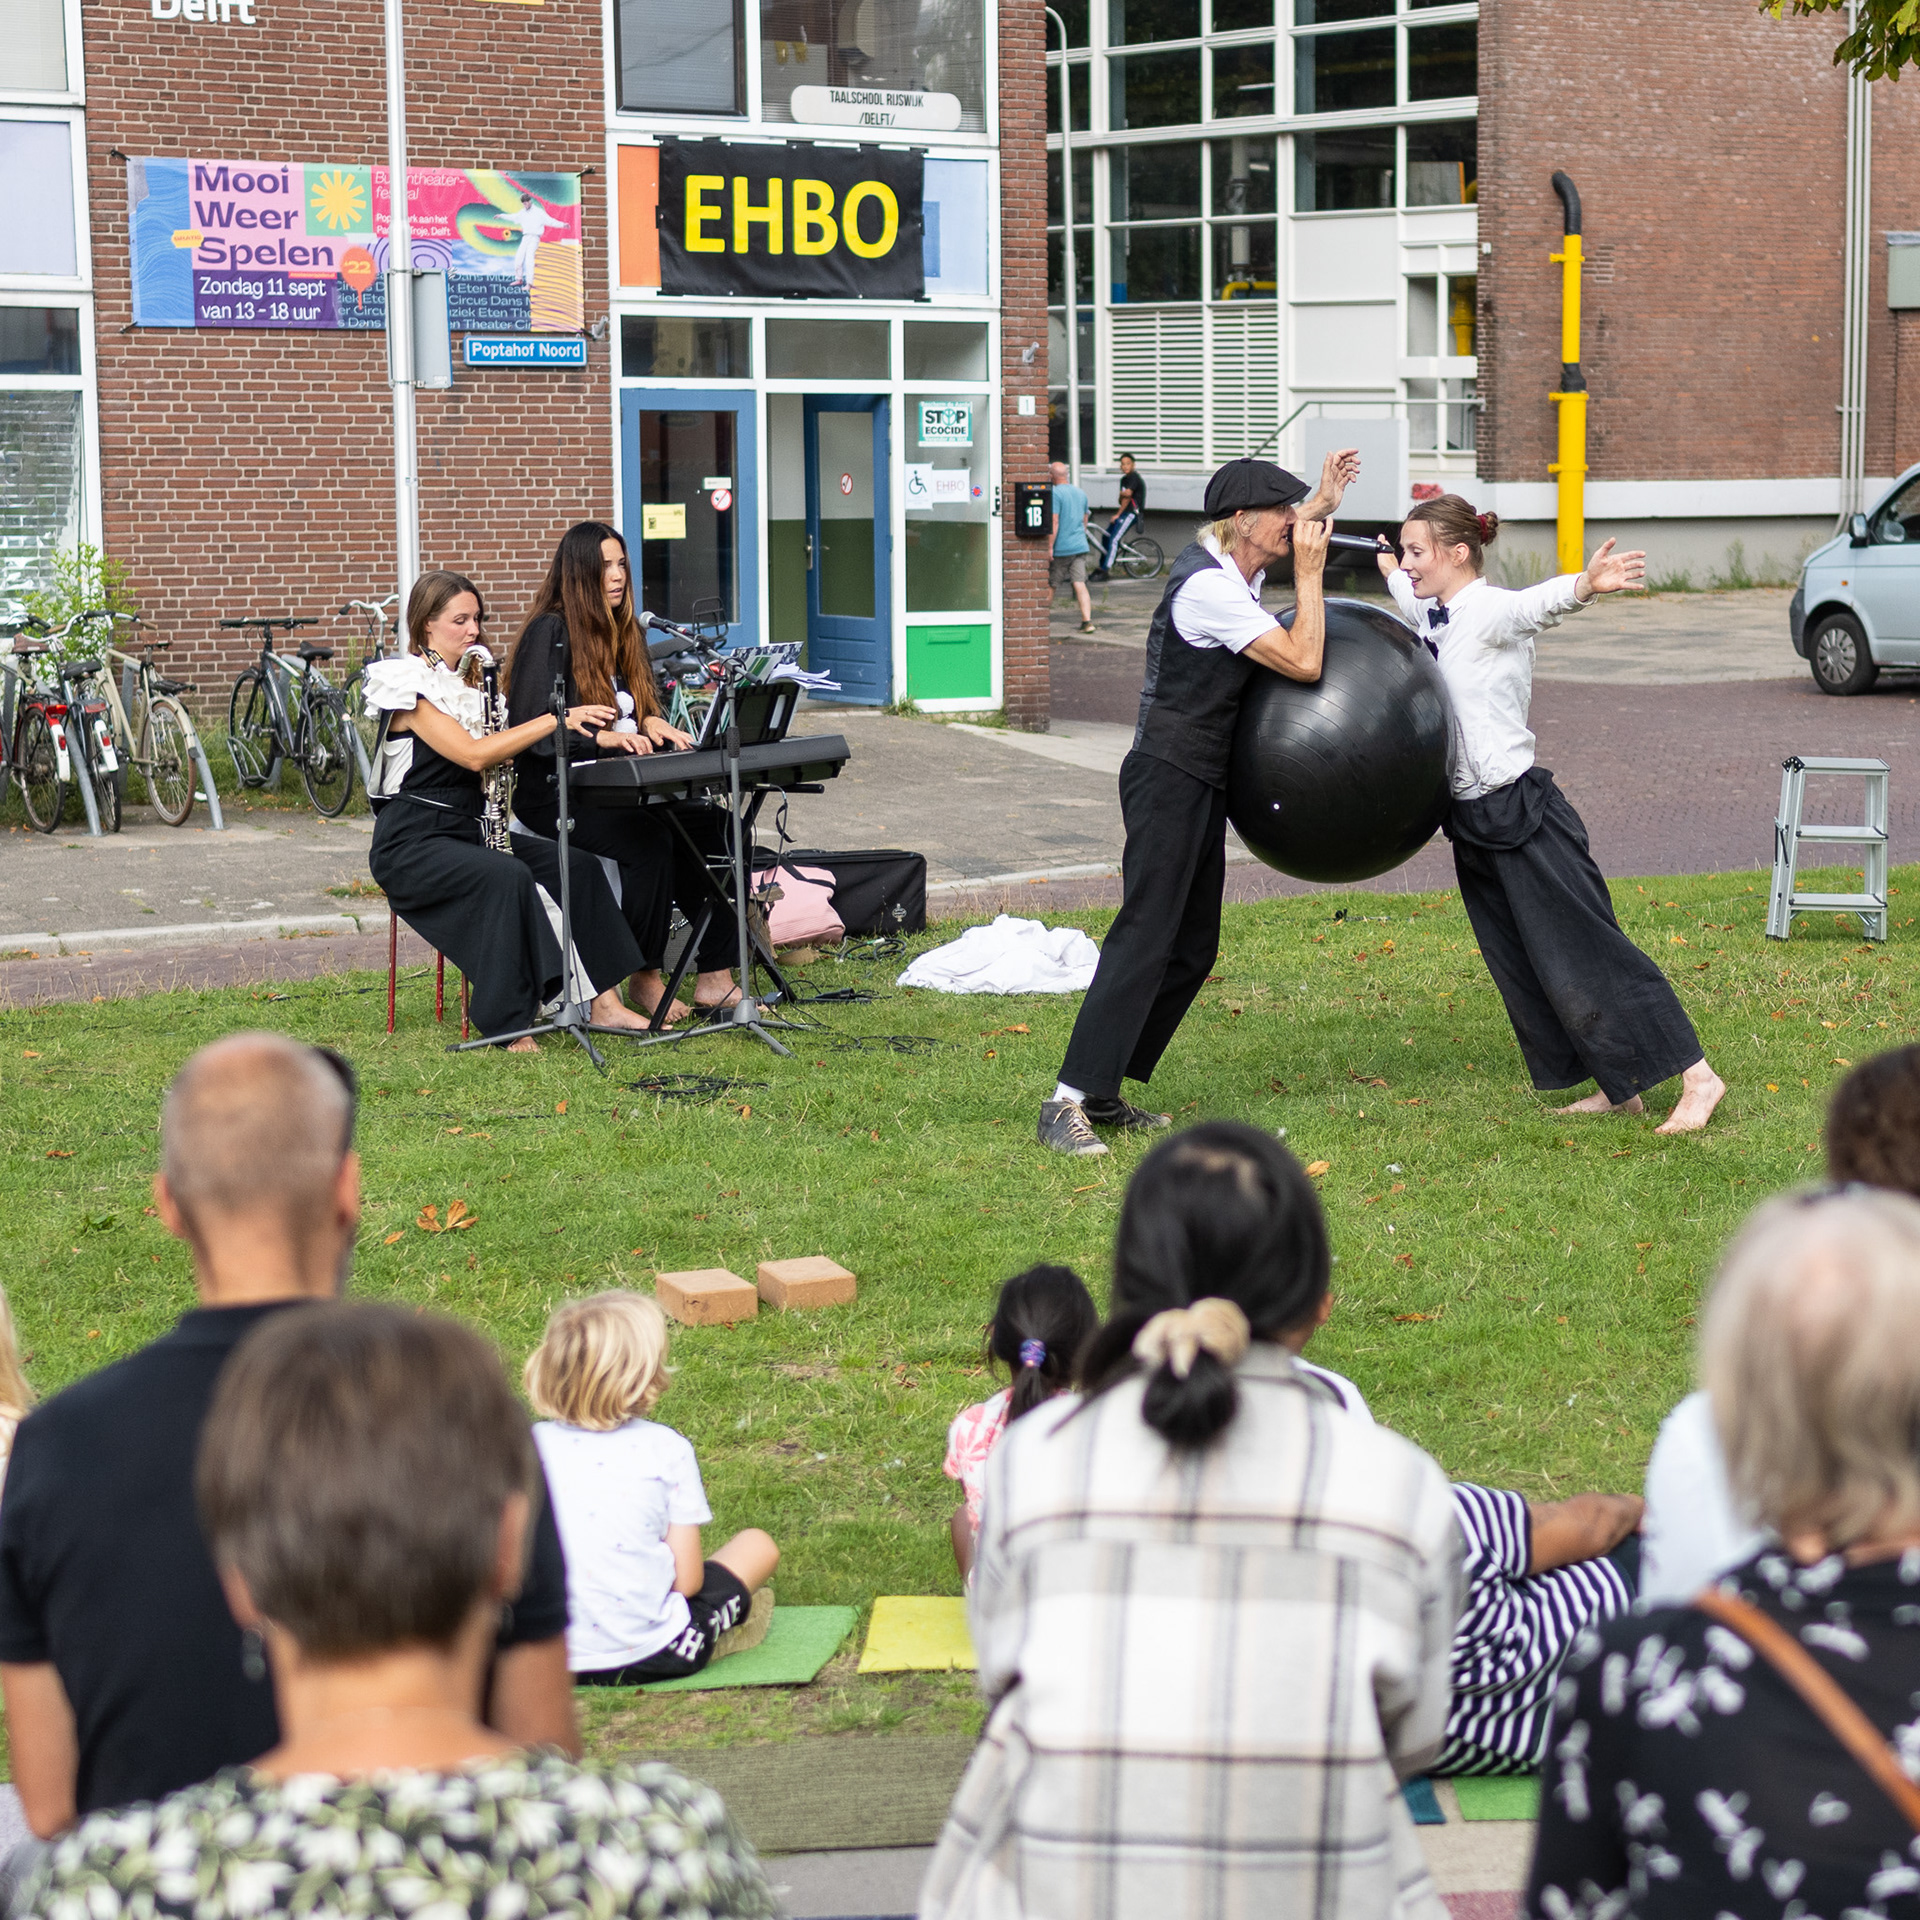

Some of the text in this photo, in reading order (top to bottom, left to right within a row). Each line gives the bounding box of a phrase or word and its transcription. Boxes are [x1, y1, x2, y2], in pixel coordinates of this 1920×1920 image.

[830, 90, 924, 107] TAALSCHOOL RIJSWIJK
[195, 165, 289, 194] Mooi
[375, 170, 466, 187] Buntheater-
[194, 201, 298, 229] Weer
[685, 174, 899, 259] EHBO
[431, 227, 452, 236] Delft
[198, 236, 334, 271] Spelen
[199, 277, 327, 300] Zondag 11 sept
[457, 283, 488, 294] Eten
[448, 295, 488, 306] Circus
[490, 296, 523, 306] Dans
[201, 305, 232, 319] van
[235, 301, 255, 320] 13
[269, 302, 289, 320] 18
[293, 306, 321, 320] uur
[478, 307, 508, 318] Eten
[348, 317, 381, 328] Dans
[463, 319, 512, 330] Theater
[471, 341, 580, 360] Poptahof Noord
[925, 426, 966, 435] ECOCIDE
[936, 480, 965, 492] EHBO
[1026, 506, 1042, 527] 1B
